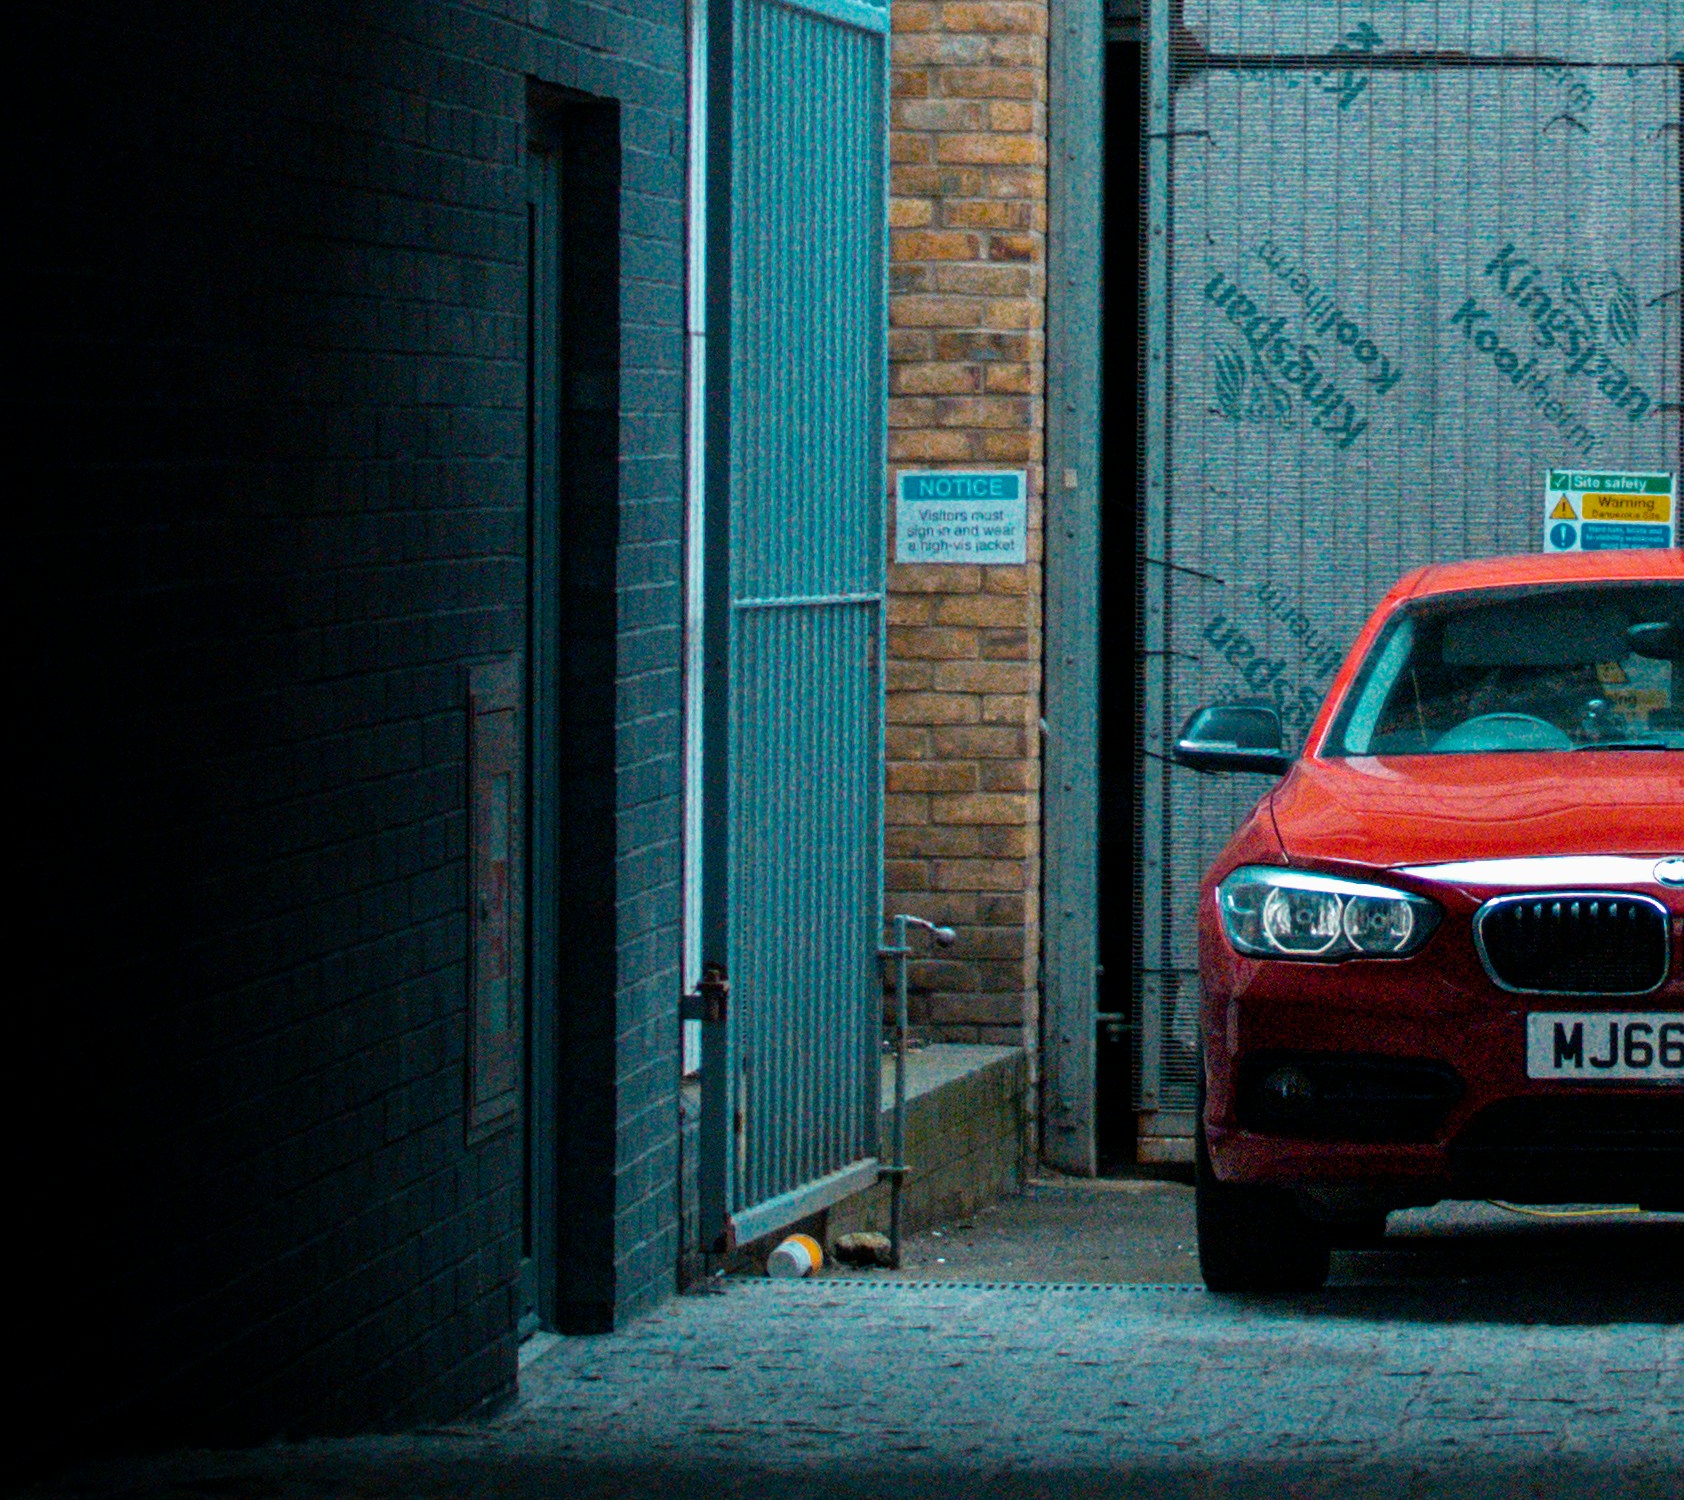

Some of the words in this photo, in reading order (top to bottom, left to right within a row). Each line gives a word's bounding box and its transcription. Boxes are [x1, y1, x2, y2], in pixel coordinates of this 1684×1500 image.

[1258, 239, 1402, 395] Kooltherm
[1484, 242, 1651, 421] Kingspan
[1204, 272, 1369, 449] Kingspan
[1450, 298, 1597, 456] Kooltherm
[919, 478, 1003, 496] NOTICE
[1574, 476, 1600, 488] Site
[1605, 478, 1647, 491] safety
[1599, 496, 1655, 511] Warning
[919, 509, 968, 521] Visitors
[971, 510, 1004, 521] must
[907, 524, 934, 538] sign
[938, 524, 950, 536] in
[954, 524, 979, 536] and
[982, 525, 1015, 536] wear
[908, 541, 917, 551] a
[920, 538, 972, 553] high-vis
[975, 538, 1015, 552] jacket
